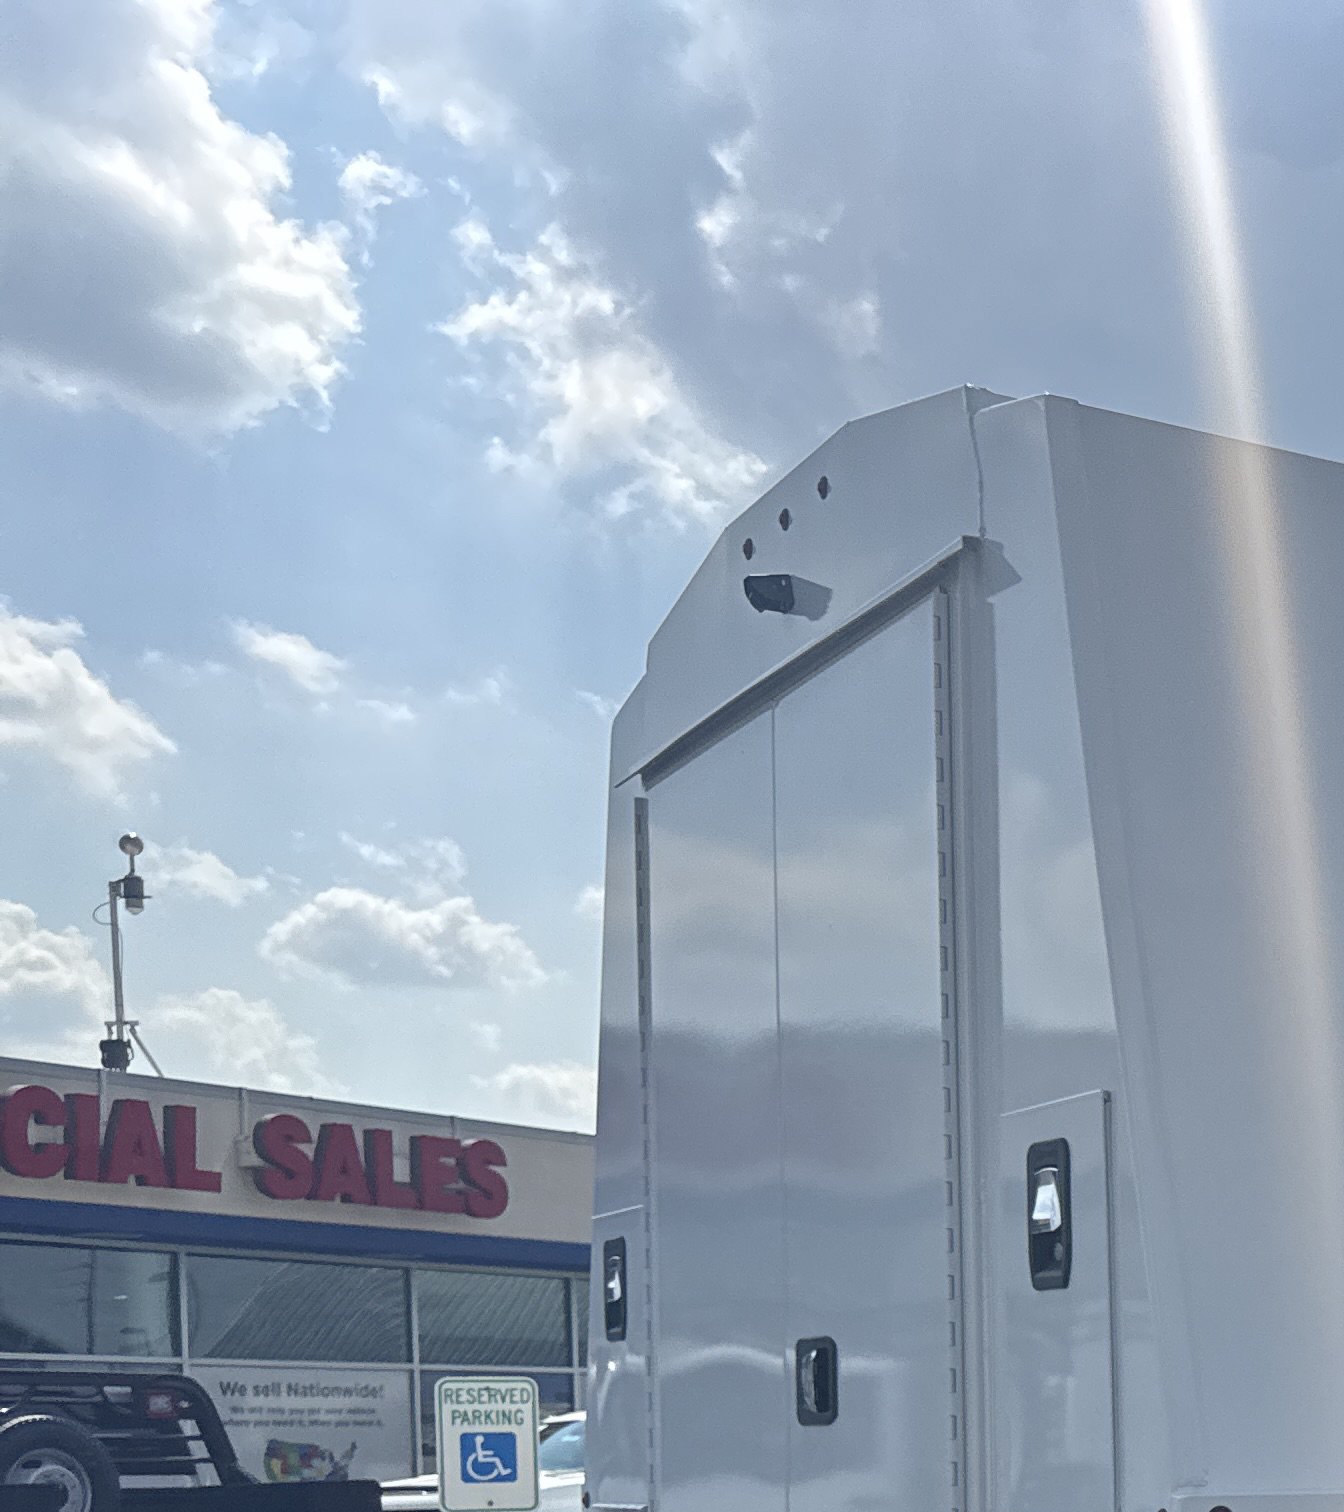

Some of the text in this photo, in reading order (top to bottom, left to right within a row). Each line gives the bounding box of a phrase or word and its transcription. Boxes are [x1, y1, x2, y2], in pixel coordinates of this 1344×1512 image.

[253, 1114, 508, 1219] SALES
[219, 1381, 248, 1398] We
[253, 1381, 281, 1398] sell
[443, 1387, 531, 1405] RESERVED
[451, 1409, 525, 1427] PARKING
